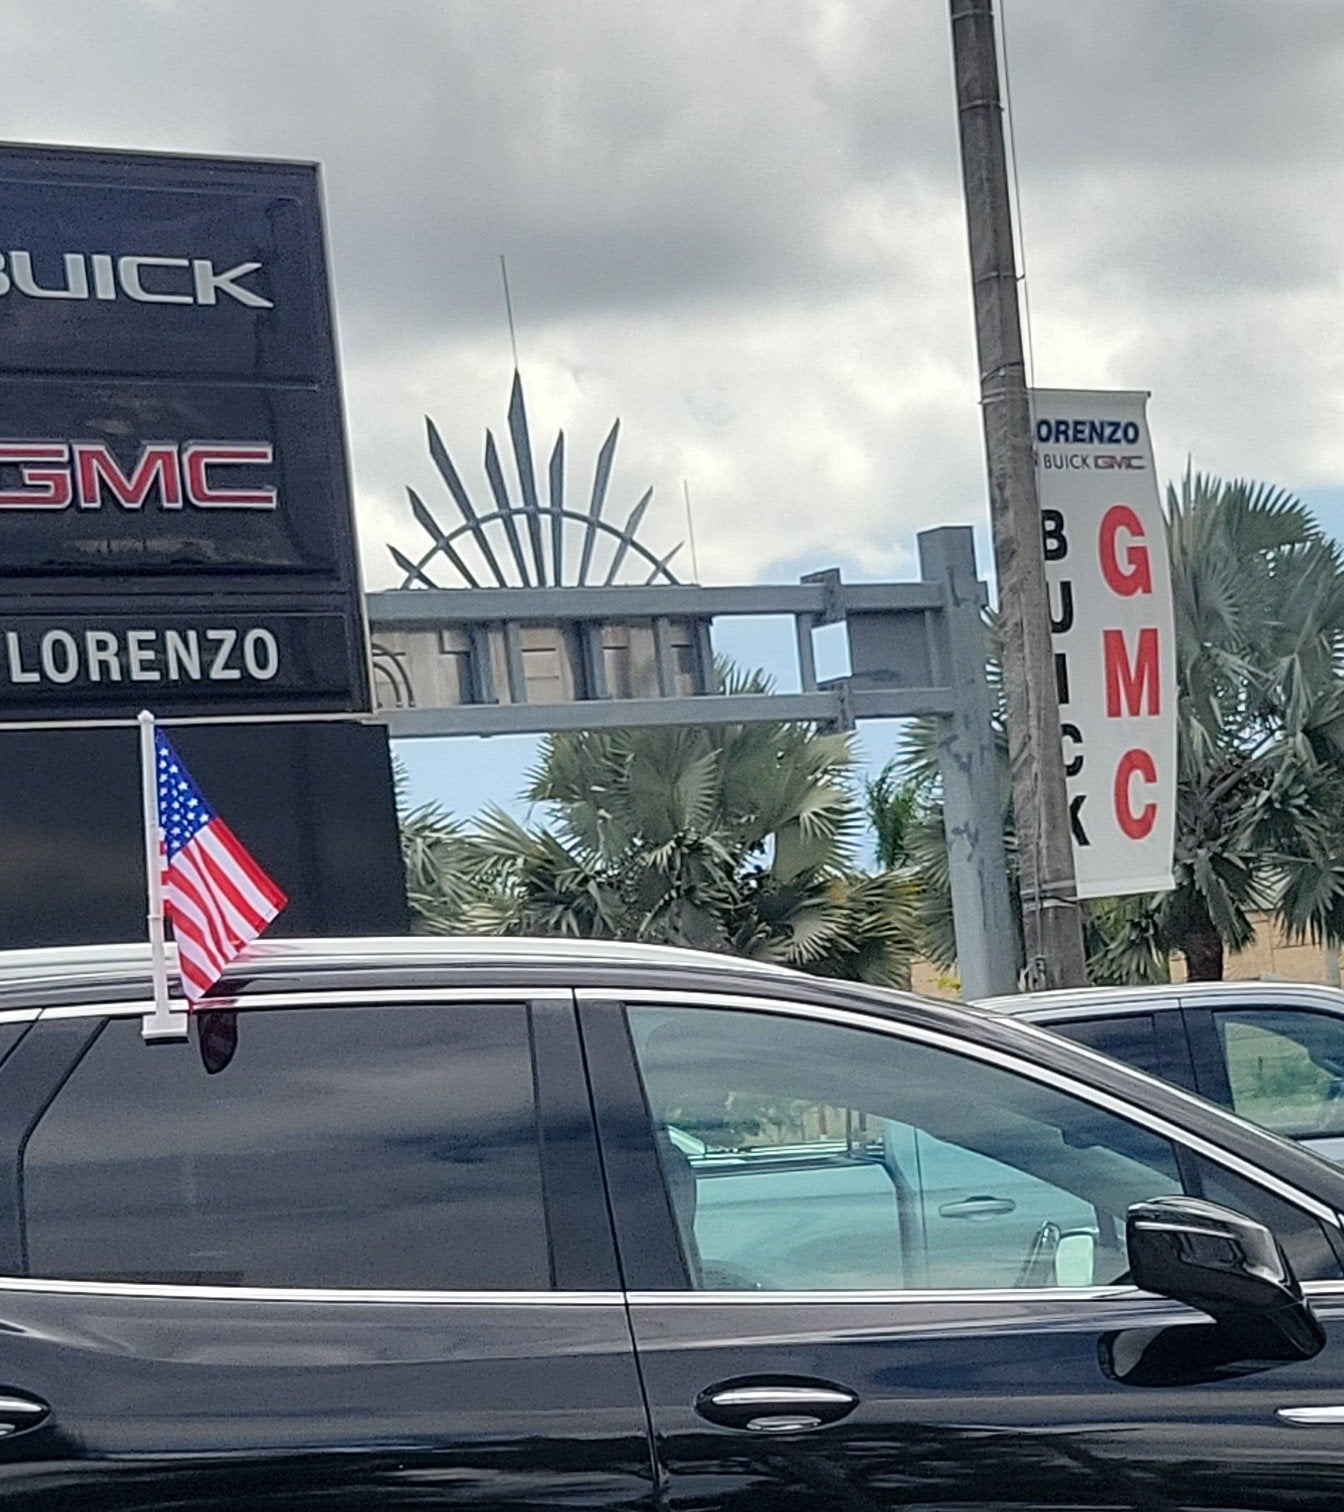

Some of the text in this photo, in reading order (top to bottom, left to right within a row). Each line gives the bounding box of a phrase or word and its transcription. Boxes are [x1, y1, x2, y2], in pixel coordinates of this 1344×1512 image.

[1036, 418, 1140, 444] ORENZO
[1043, 454, 1146, 470] BUICK GMC
[6, 628, 280, 685] LORENZO
[1098, 504, 1161, 841] GMC
